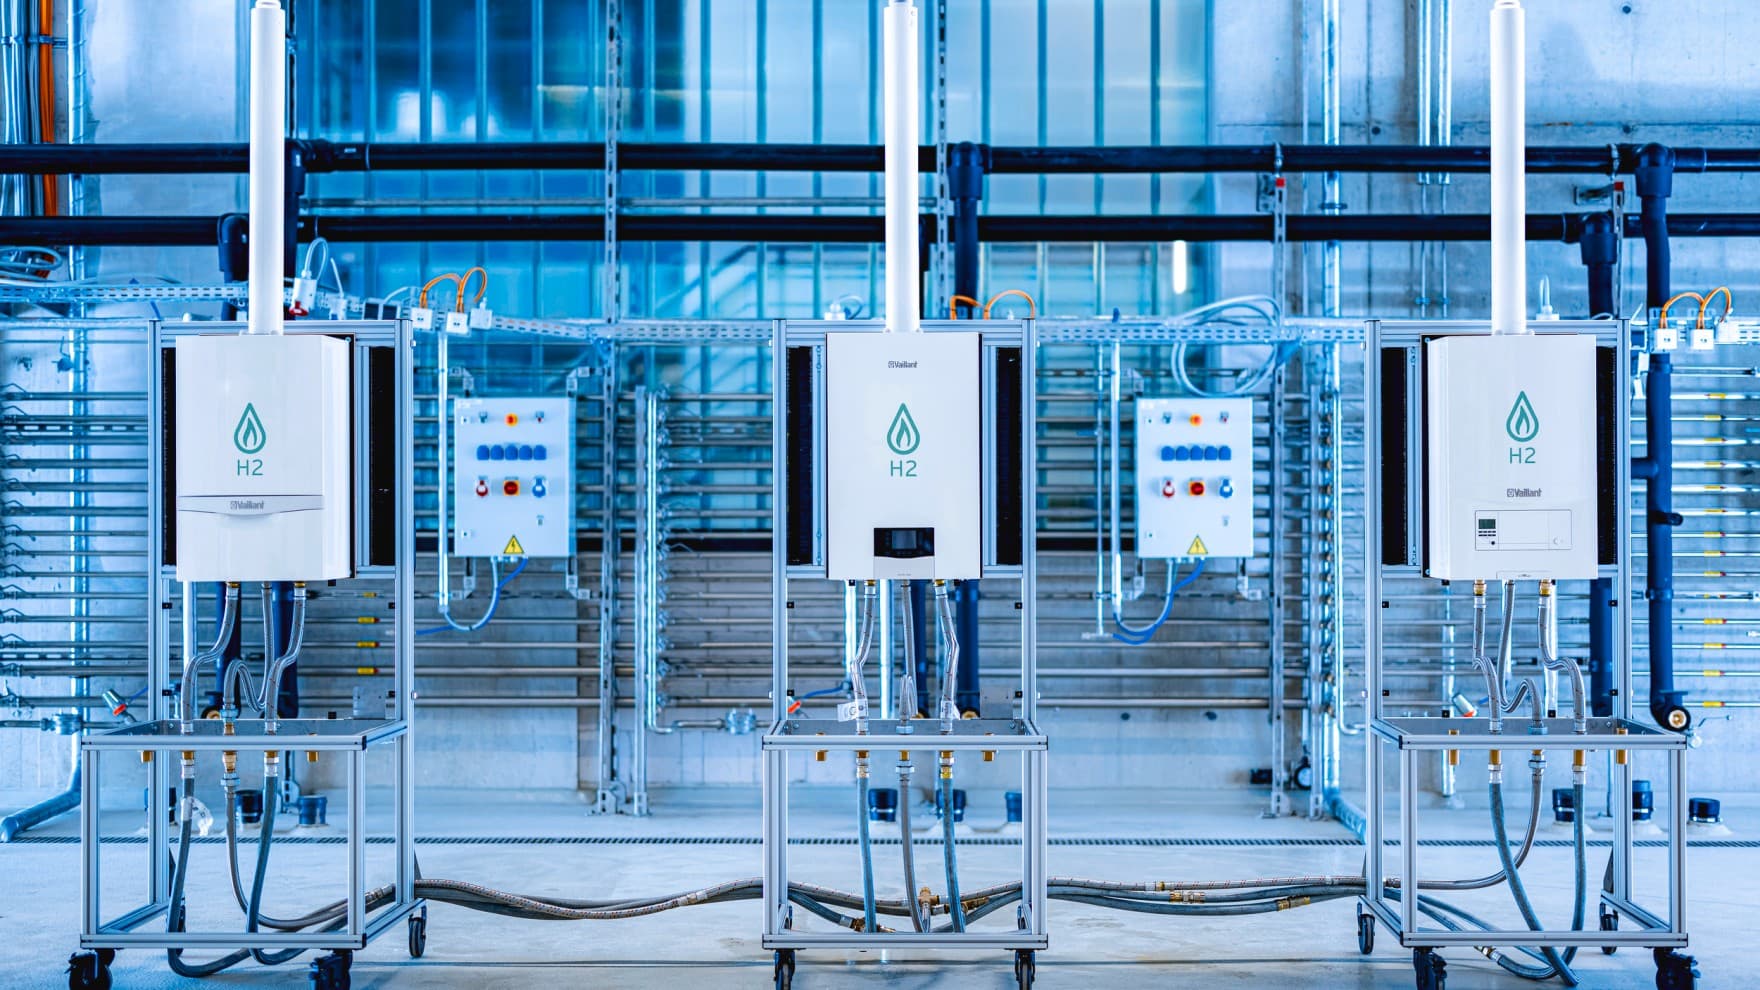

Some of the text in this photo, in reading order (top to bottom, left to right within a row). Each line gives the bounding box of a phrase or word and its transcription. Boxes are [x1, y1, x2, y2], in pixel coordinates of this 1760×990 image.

[894, 360, 918, 369] Vaillant
[1509, 446, 1537, 465] H2
[237, 459, 264, 476] H2
[890, 460, 918, 477] H2
[1514, 488, 1542, 498] Vaillant
[236, 500, 264, 510] Vaillant
